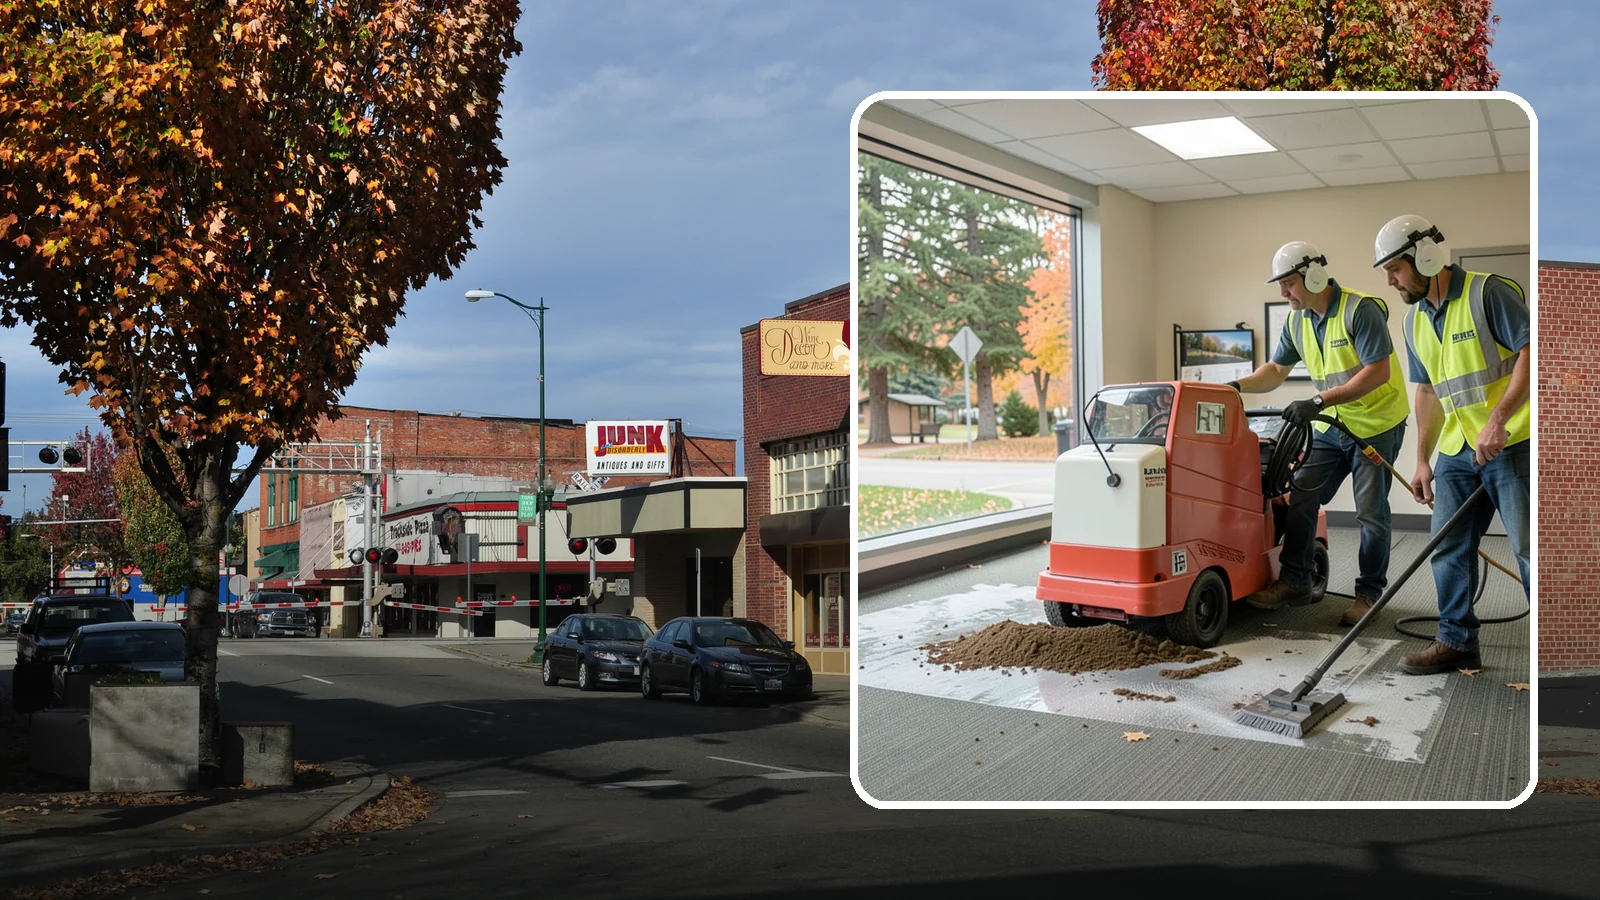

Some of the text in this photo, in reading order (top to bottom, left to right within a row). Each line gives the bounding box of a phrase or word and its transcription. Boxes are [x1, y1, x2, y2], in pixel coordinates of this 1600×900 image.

[595, 425, 665, 458] JUNK
[607, 446, 646, 454] DISORDERLY
[596, 460, 665, 470] ANTIQUES AND GIFTS
[590, 476, 608, 491] SING
[352, 498, 365, 511] CRO
